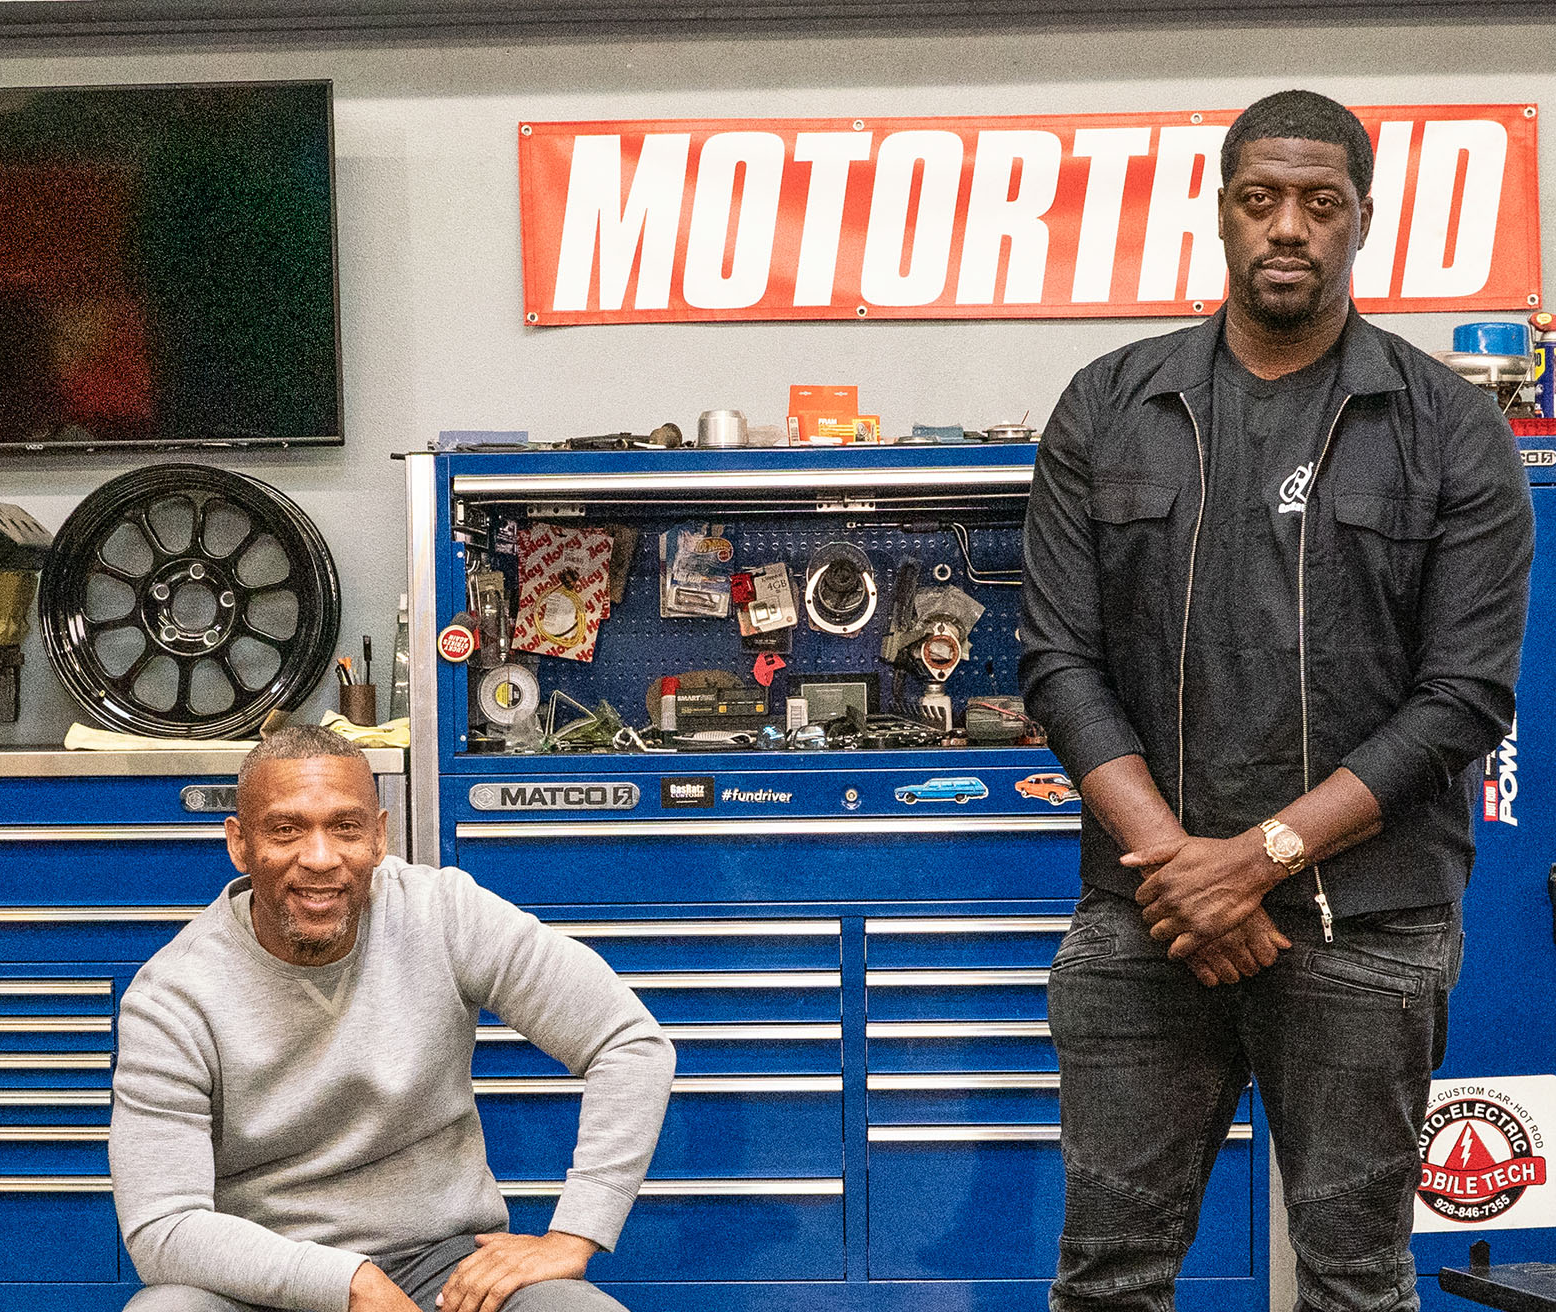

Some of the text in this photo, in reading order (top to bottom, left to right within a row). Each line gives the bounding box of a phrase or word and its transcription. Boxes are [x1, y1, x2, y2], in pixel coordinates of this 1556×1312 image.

[553, 121, 1508, 311] MOTORTRD
[767, 579, 787, 591] 4GB
[1498, 691, 1518, 827] POW
[500, 786, 608, 806] MATCO
[721, 788, 793, 803] #fundriver
[1436, 1085, 1545, 1150] CUSTOM CAR HOT ROD
[1421, 1162, 1536, 1195] OBILE TECH
[1433, 1194, 1511, 1218] 928-846-7355
